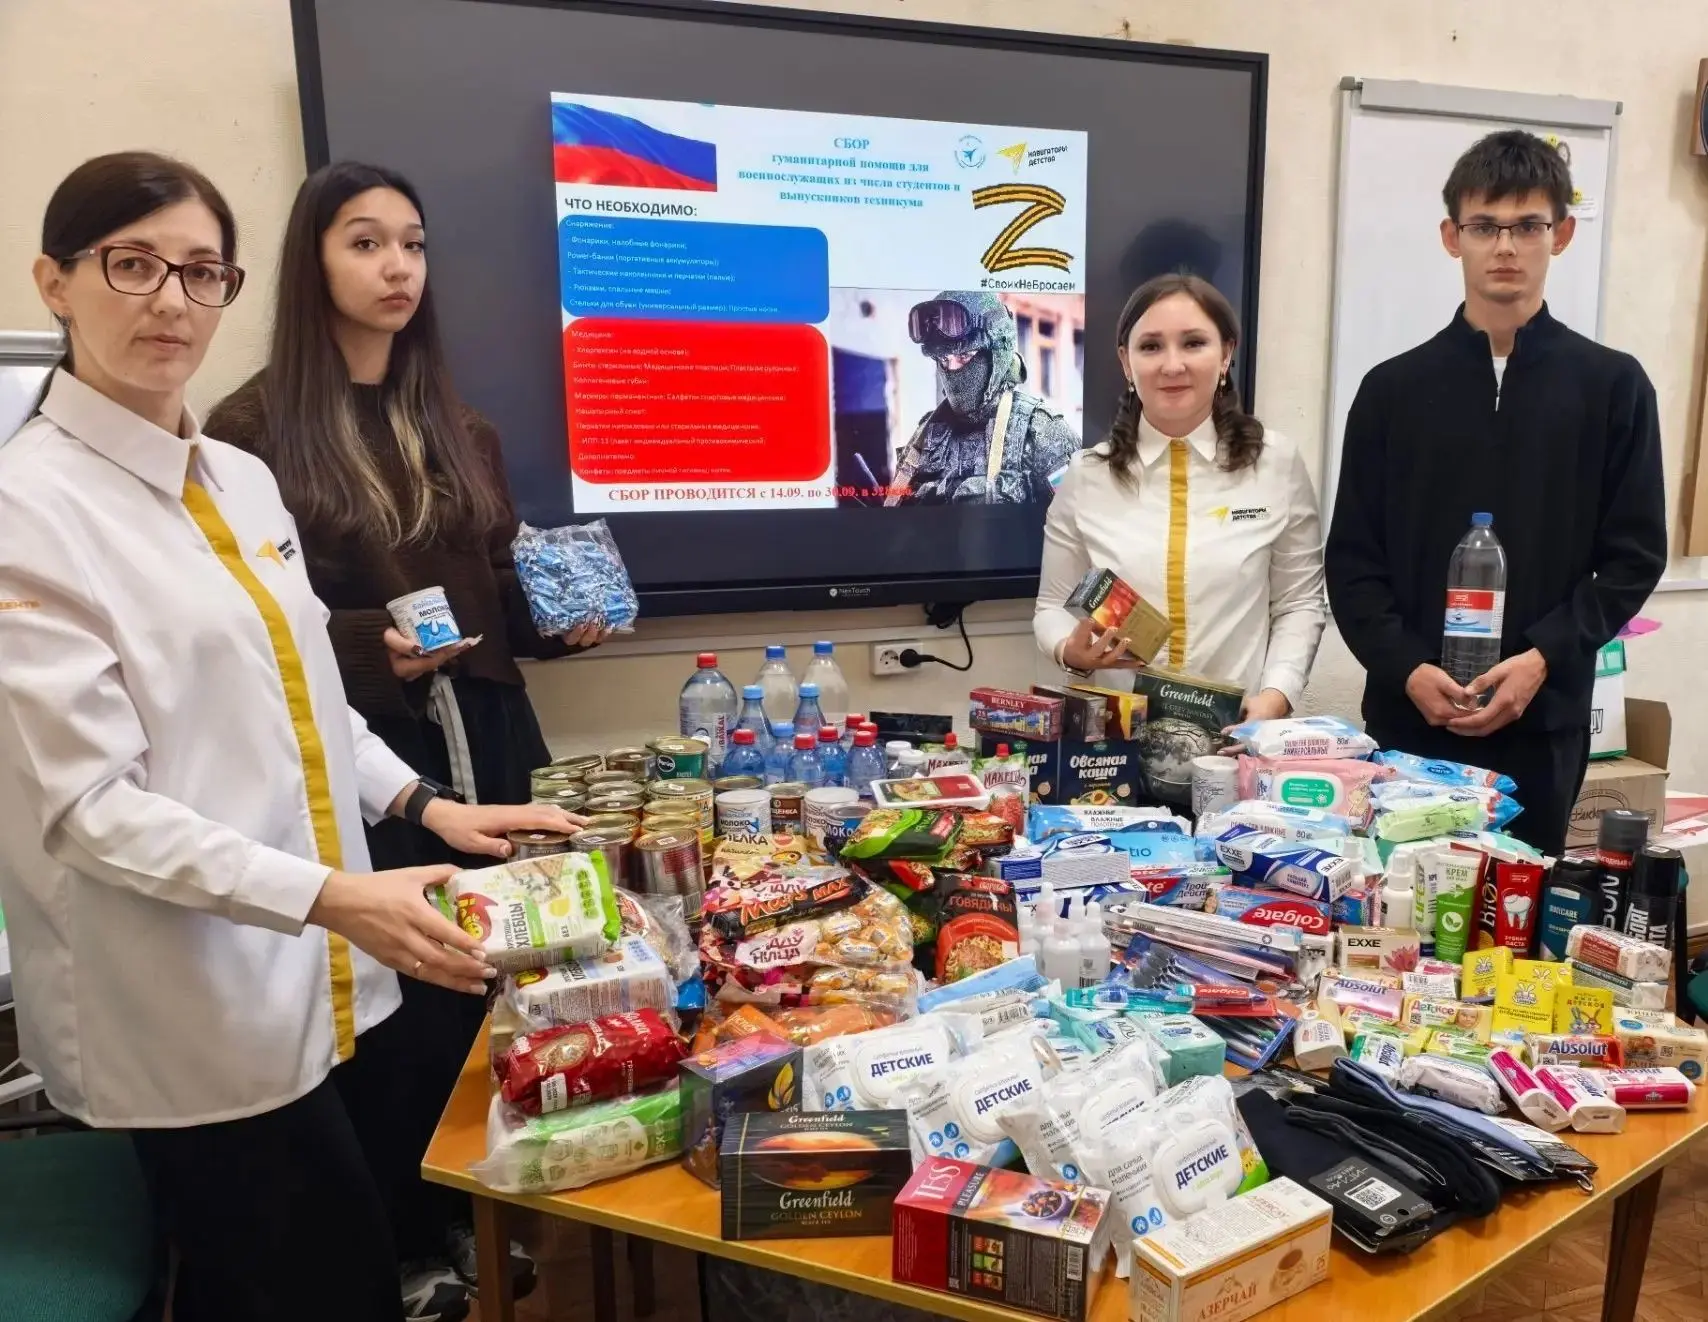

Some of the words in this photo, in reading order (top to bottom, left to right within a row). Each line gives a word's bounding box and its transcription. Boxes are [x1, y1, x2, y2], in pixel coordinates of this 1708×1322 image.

[833, 137, 870, 150] СБОР
[772, 154, 856, 168] гуманитарной
[860, 159, 905, 171] помощи
[909, 163, 929, 172] для
[738, 170, 840, 185] военнослужащих
[860, 178, 893, 188] числа
[896, 180, 950, 193] студентов
[565, 198, 592, 210] ЧТО
[596, 200, 697, 216] НЕОБХОДИМО:
[780, 191, 860, 205] выпускников
[864, 196, 924, 208] техникума
[980, 278, 1075, 291] #СвоихНеБросаем
[609, 490, 649, 501] СБОР
[655, 488, 756, 501] ПРОВОДИТСЯ
[760, 491, 766, 499] с
[771, 488, 804, 499] 14.09.
[808, 490, 821, 499] по
[991, 697, 1025, 708] BERNLEY
[1160, 684, 1215, 707] Greenfield
[1069, 755, 1127, 768] Овсяная
[1078, 767, 1118, 780] каша
[1220, 845, 1244, 858] EXXE
[1446, 868, 1467, 877] КРЕМ
[740, 889, 808, 926] Mars
[508, 902, 531, 947] ХЛЕБЦЫ
[1254, 907, 1324, 929] Colgate
[1348, 938, 1381, 948] EXXE
[1334, 979, 1387, 995] Absolut
[1411, 1000, 1455, 1015] Детское
[1549, 1040, 1608, 1055] Absolut
[871, 1053, 934, 1077] ДЕТСКИЕ
[974, 1079, 1033, 1115] ДЕТСКИЕ
[789, 1114, 845, 1123] Greenfield
[1175, 1145, 1229, 1190] ДЕТСКИЕ
[910, 1162, 960, 1199] TESS
[957, 1172, 984, 1206] PLEASURE
[780, 1190, 855, 1210] Greenfield
[771, 1212, 817, 1221] GOLDEN
[819, 1210, 862, 1219] CEYLON
[1200, 1280, 1258, 1320] АЗЕРЧАЙ
